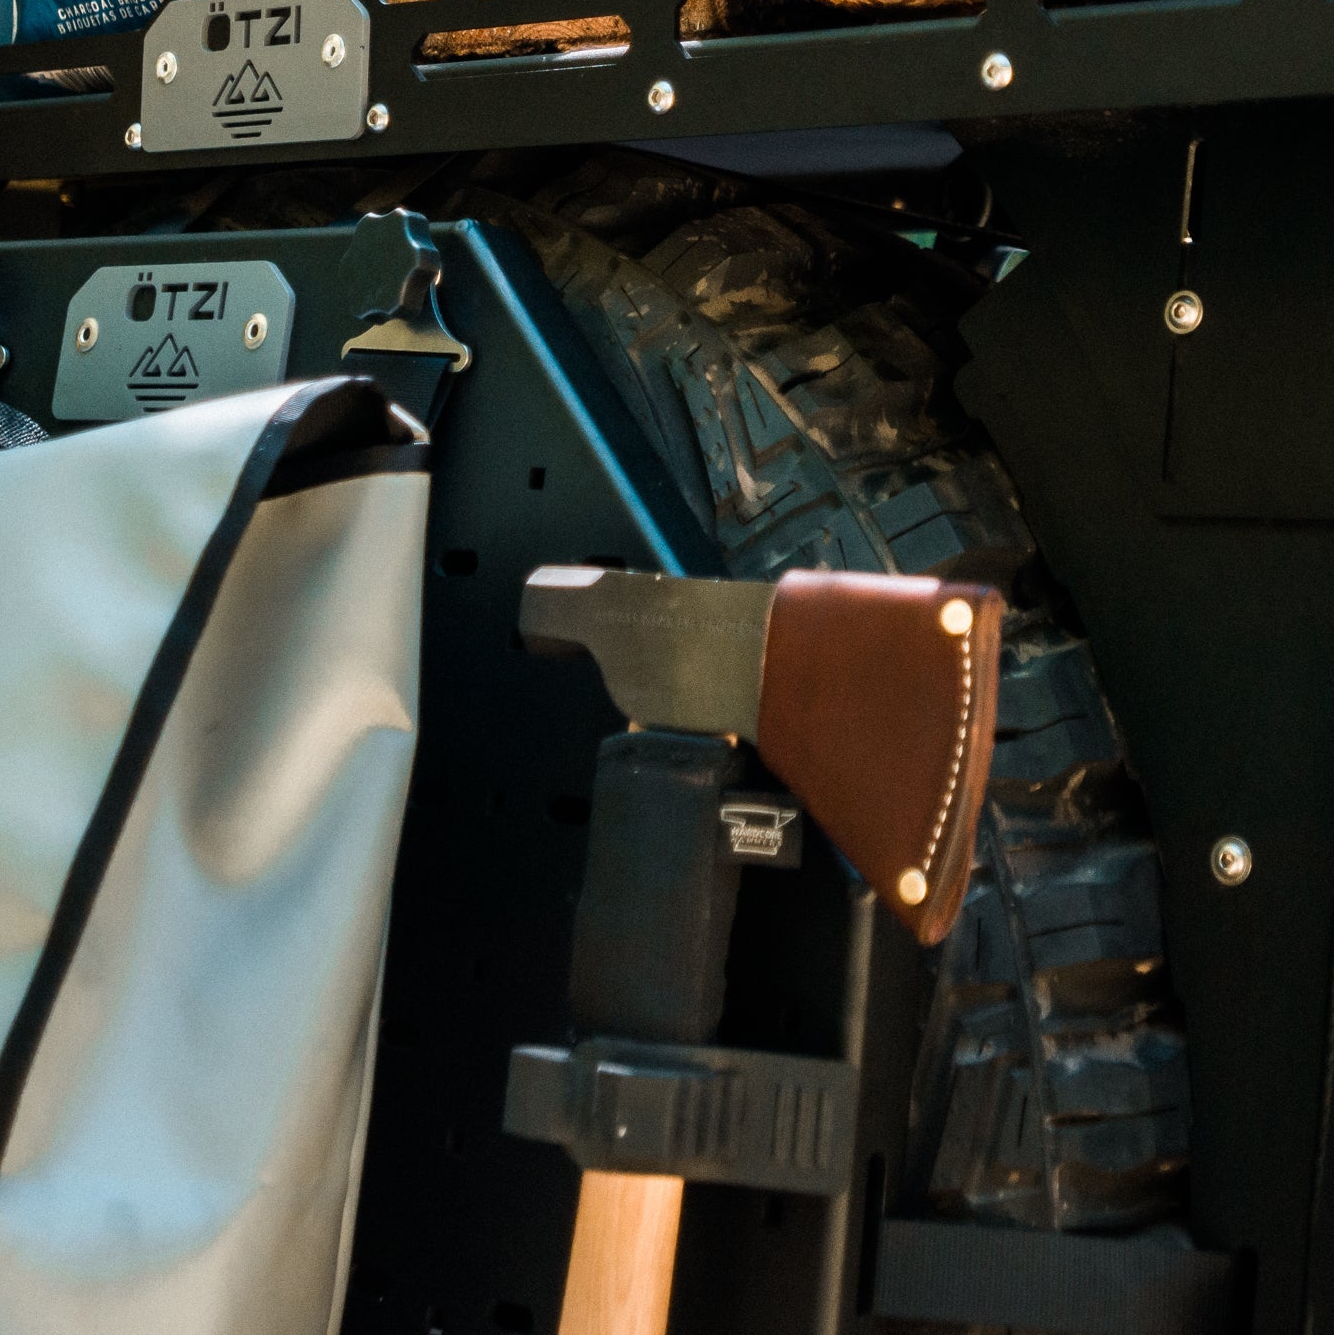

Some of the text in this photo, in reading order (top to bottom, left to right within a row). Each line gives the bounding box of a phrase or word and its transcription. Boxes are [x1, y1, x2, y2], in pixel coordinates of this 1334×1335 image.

[57, 9, 117, 35] BRIQUETAS
[119, 5, 134, 19] DE
[200, 1, 302, 53] ÖTZI
[124, 271, 229, 323] ÖTZI
